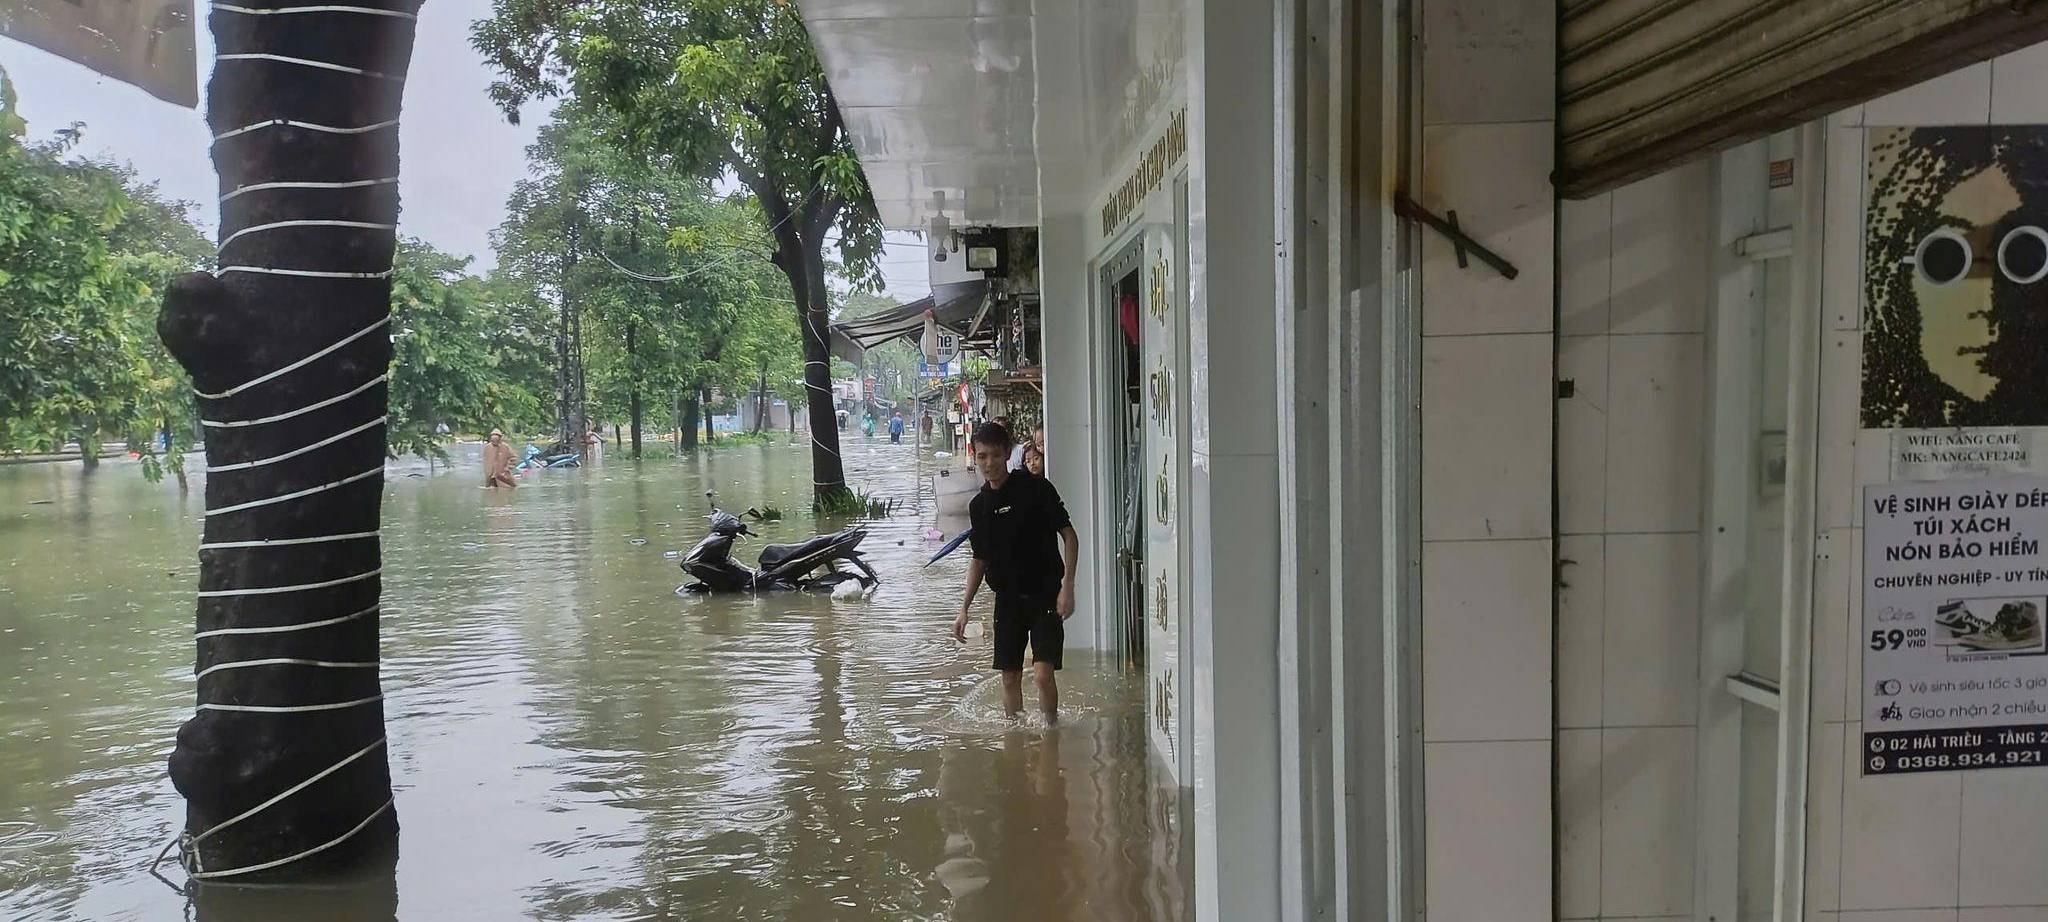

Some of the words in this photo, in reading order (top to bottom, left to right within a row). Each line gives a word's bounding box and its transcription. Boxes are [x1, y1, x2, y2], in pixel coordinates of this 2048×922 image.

[1150, 354, 1171, 438] SẢN
[1901, 452, 1928, 463] MK:
[1874, 494, 1898, 518] VỆ
[1904, 496, 1950, 513] SINH
[1958, 489, 2009, 511] GIÀY
[1914, 516, 1943, 536] TÚI
[1950, 513, 2011, 535] XÁCH
[1886, 541, 1931, 562] NÓN
[1939, 537, 1982, 559] BẢO
[1989, 532, 2038, 557] HIỂM
[1874, 573, 1933, 588] CHUYÊN
[1937, 569, 1992, 586] NGHIỆP
[2005, 571, 2023, 582] UY
[1871, 629, 1905, 651] 59
[1907, 628, 1927, 638] 000
[1931, 680, 1956, 692] sinh
[2014, 677, 2022, 689] 3
[1909, 706, 1945, 720] Giao
[1950, 703, 1987, 718] nhận
[1992, 703, 2001, 716] 2
[1890, 738, 1907, 751] 02
[2040, 731, 2048, 744] 2
[1898, 750, 2042, 769] 0368.934.921
